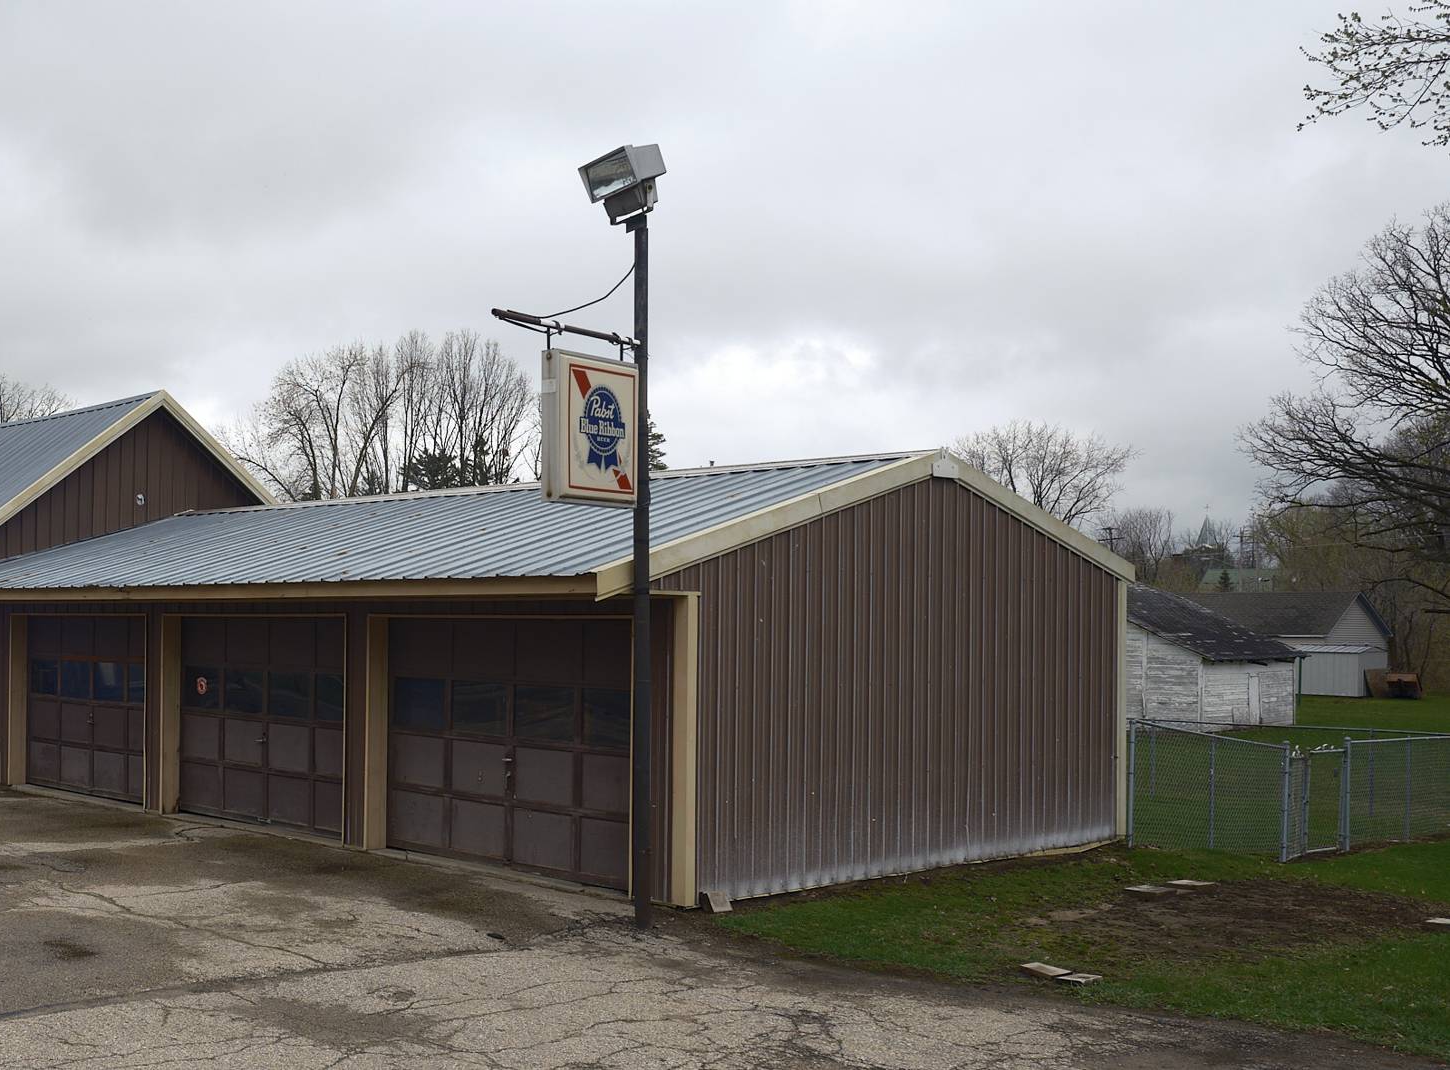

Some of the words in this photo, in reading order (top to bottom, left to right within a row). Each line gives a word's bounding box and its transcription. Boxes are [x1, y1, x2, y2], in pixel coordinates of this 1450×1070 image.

[590, 396, 615, 419] Pabst
[580, 418, 598, 434] Blue
[598, 420, 624, 437] Ribbon
